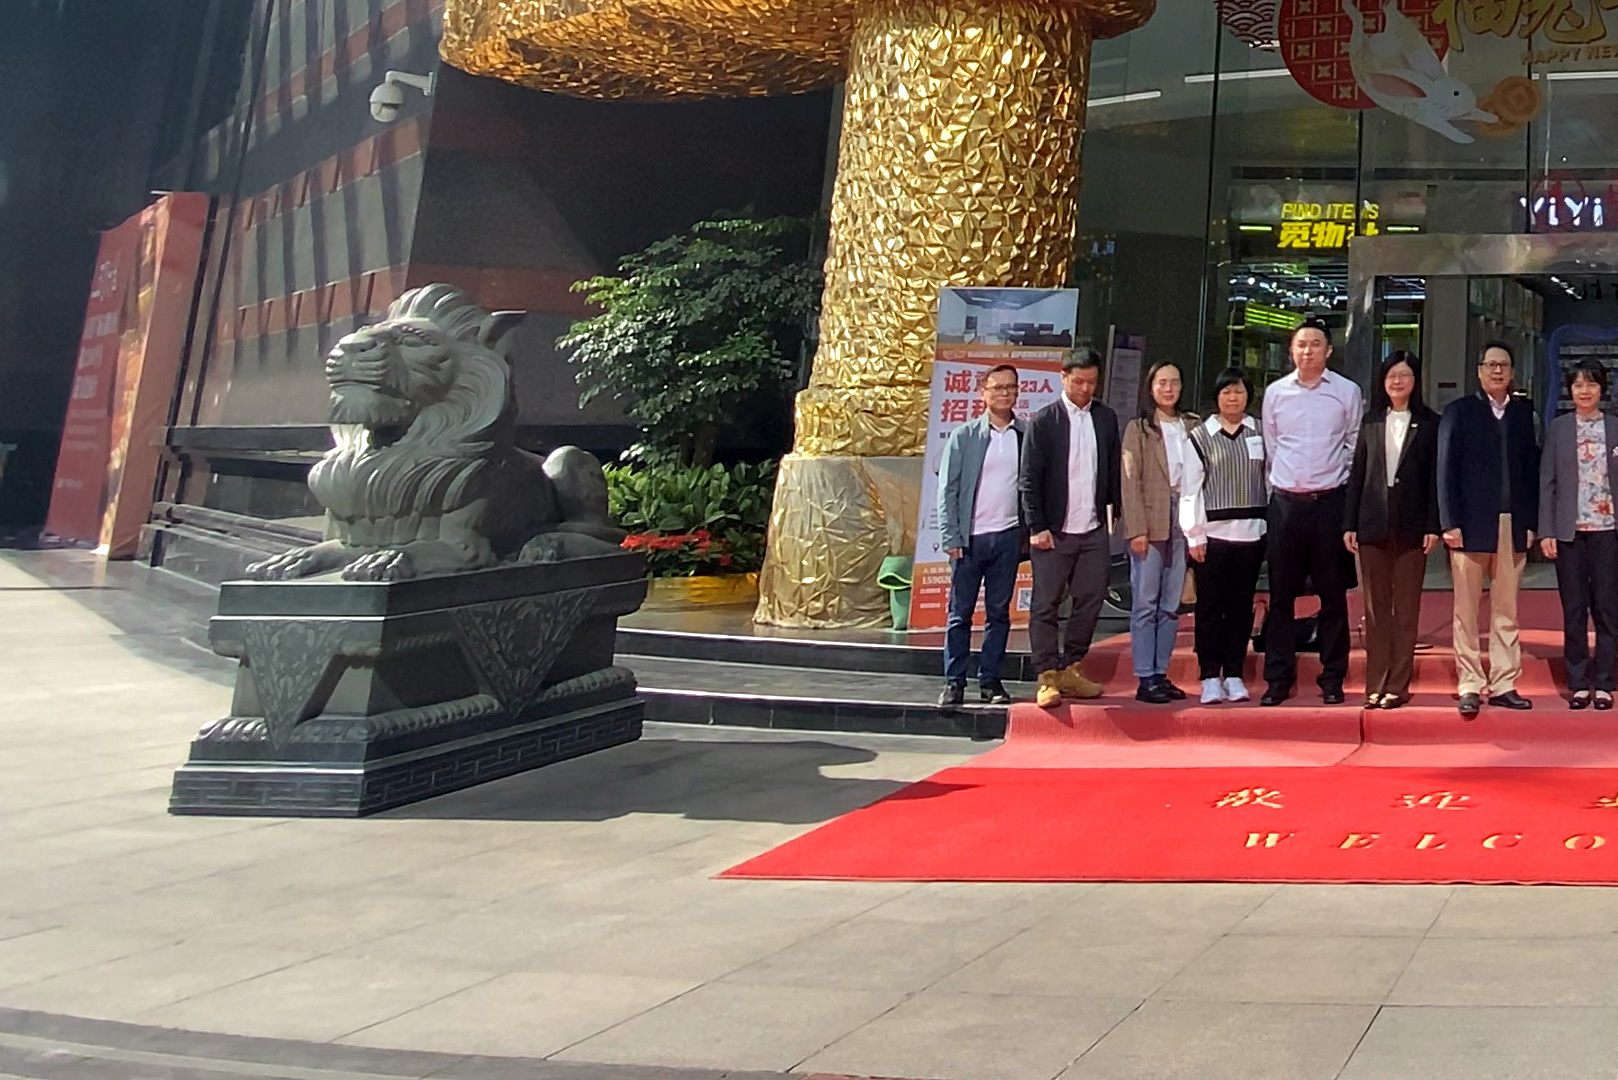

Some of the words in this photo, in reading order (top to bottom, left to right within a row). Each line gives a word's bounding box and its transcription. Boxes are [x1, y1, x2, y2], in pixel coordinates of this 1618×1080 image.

[1521, 47, 1582, 66] HAPPY
[1281, 203, 1321, 219] FIND
[1325, 203, 1379, 219] ITES
